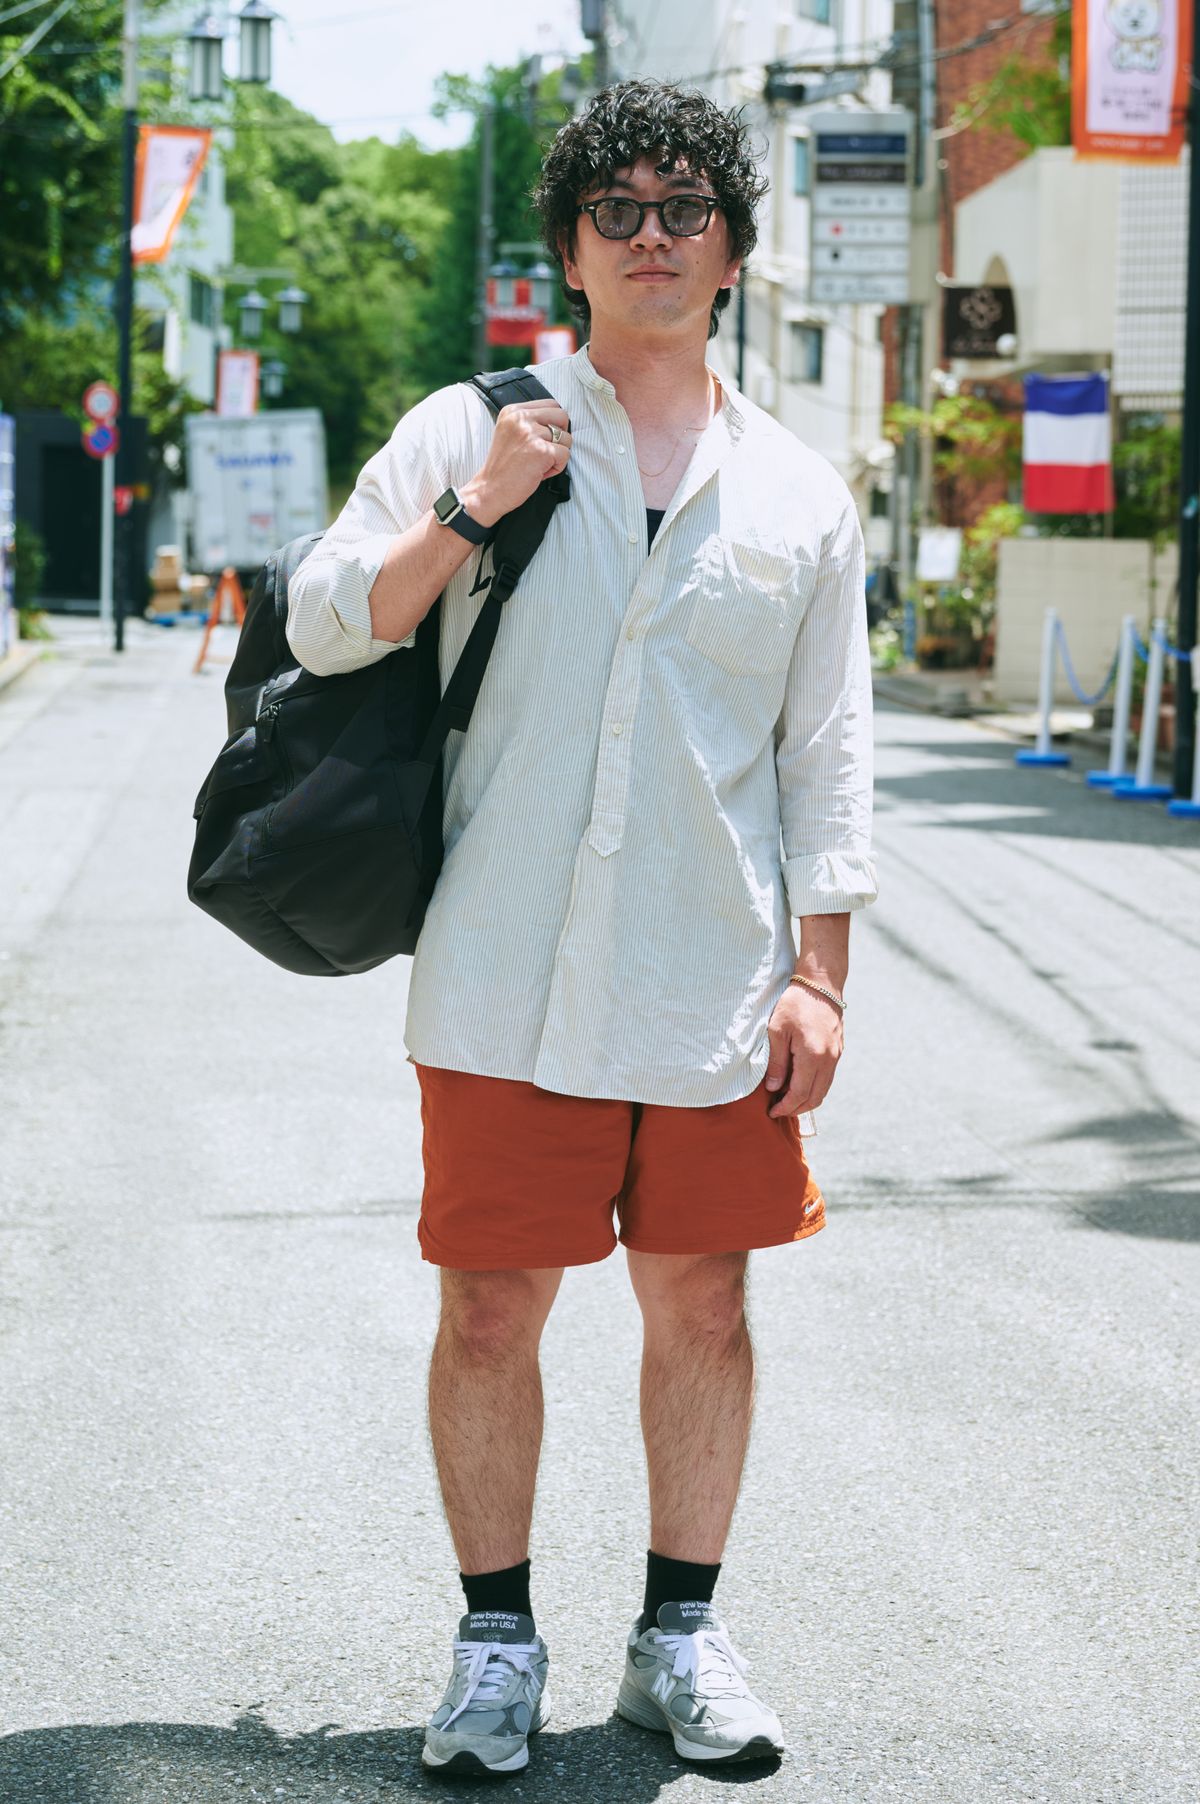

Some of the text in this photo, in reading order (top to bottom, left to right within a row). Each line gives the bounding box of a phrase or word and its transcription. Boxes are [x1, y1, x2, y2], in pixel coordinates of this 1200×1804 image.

[470, 1612, 519, 1621] new balance
[681, 1609, 701, 1617] Made
[470, 1620, 516, 1630] Made in USA
